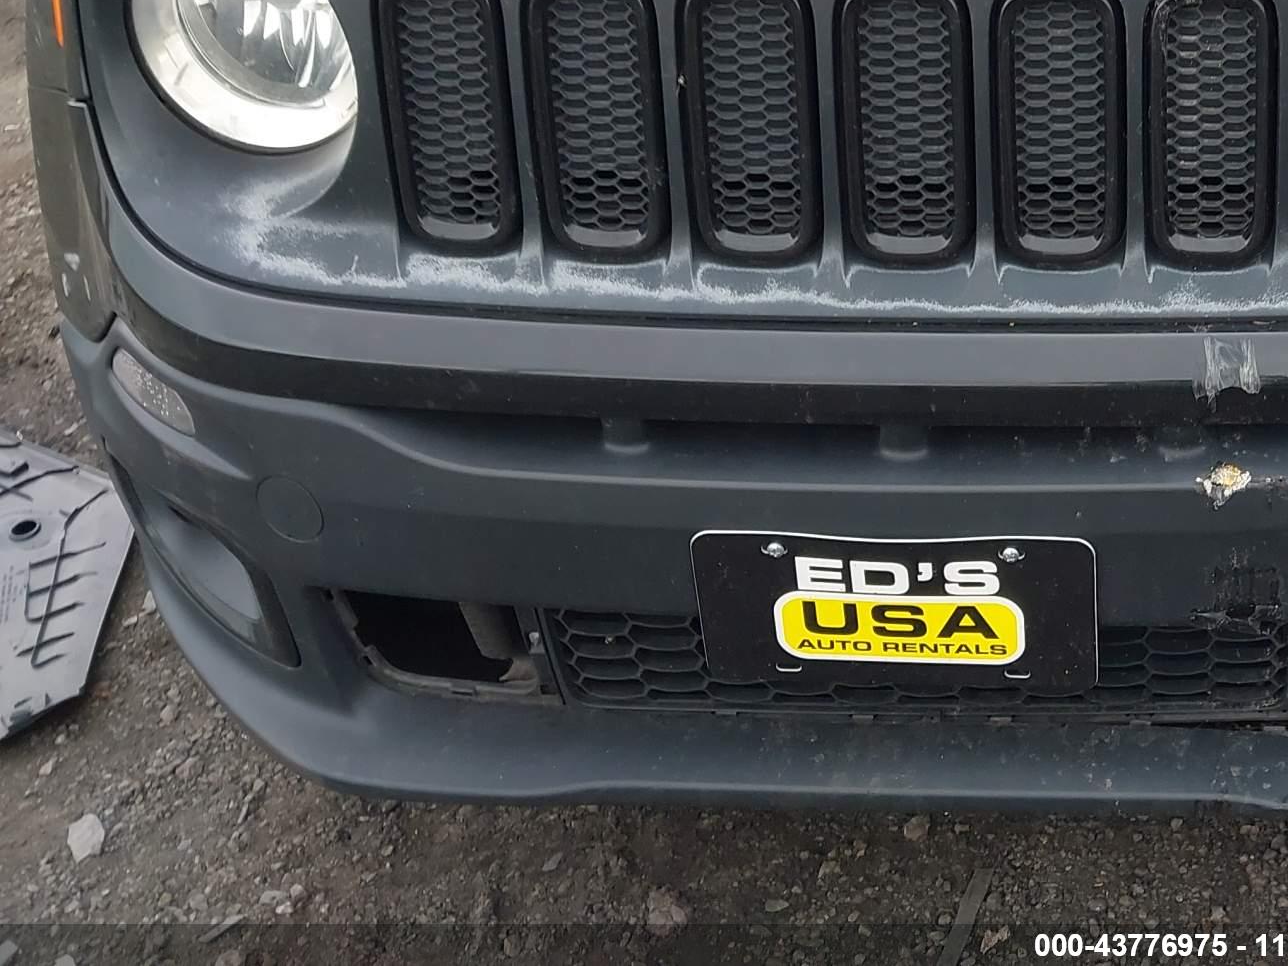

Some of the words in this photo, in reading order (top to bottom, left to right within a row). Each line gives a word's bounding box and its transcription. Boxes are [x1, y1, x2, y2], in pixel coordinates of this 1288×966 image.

[794, 555, 1001, 596] ED'S
[801, 600, 1000, 640] USA
[796, 638, 873, 652] AUTO
[882, 642, 1008, 656] RENTALS
